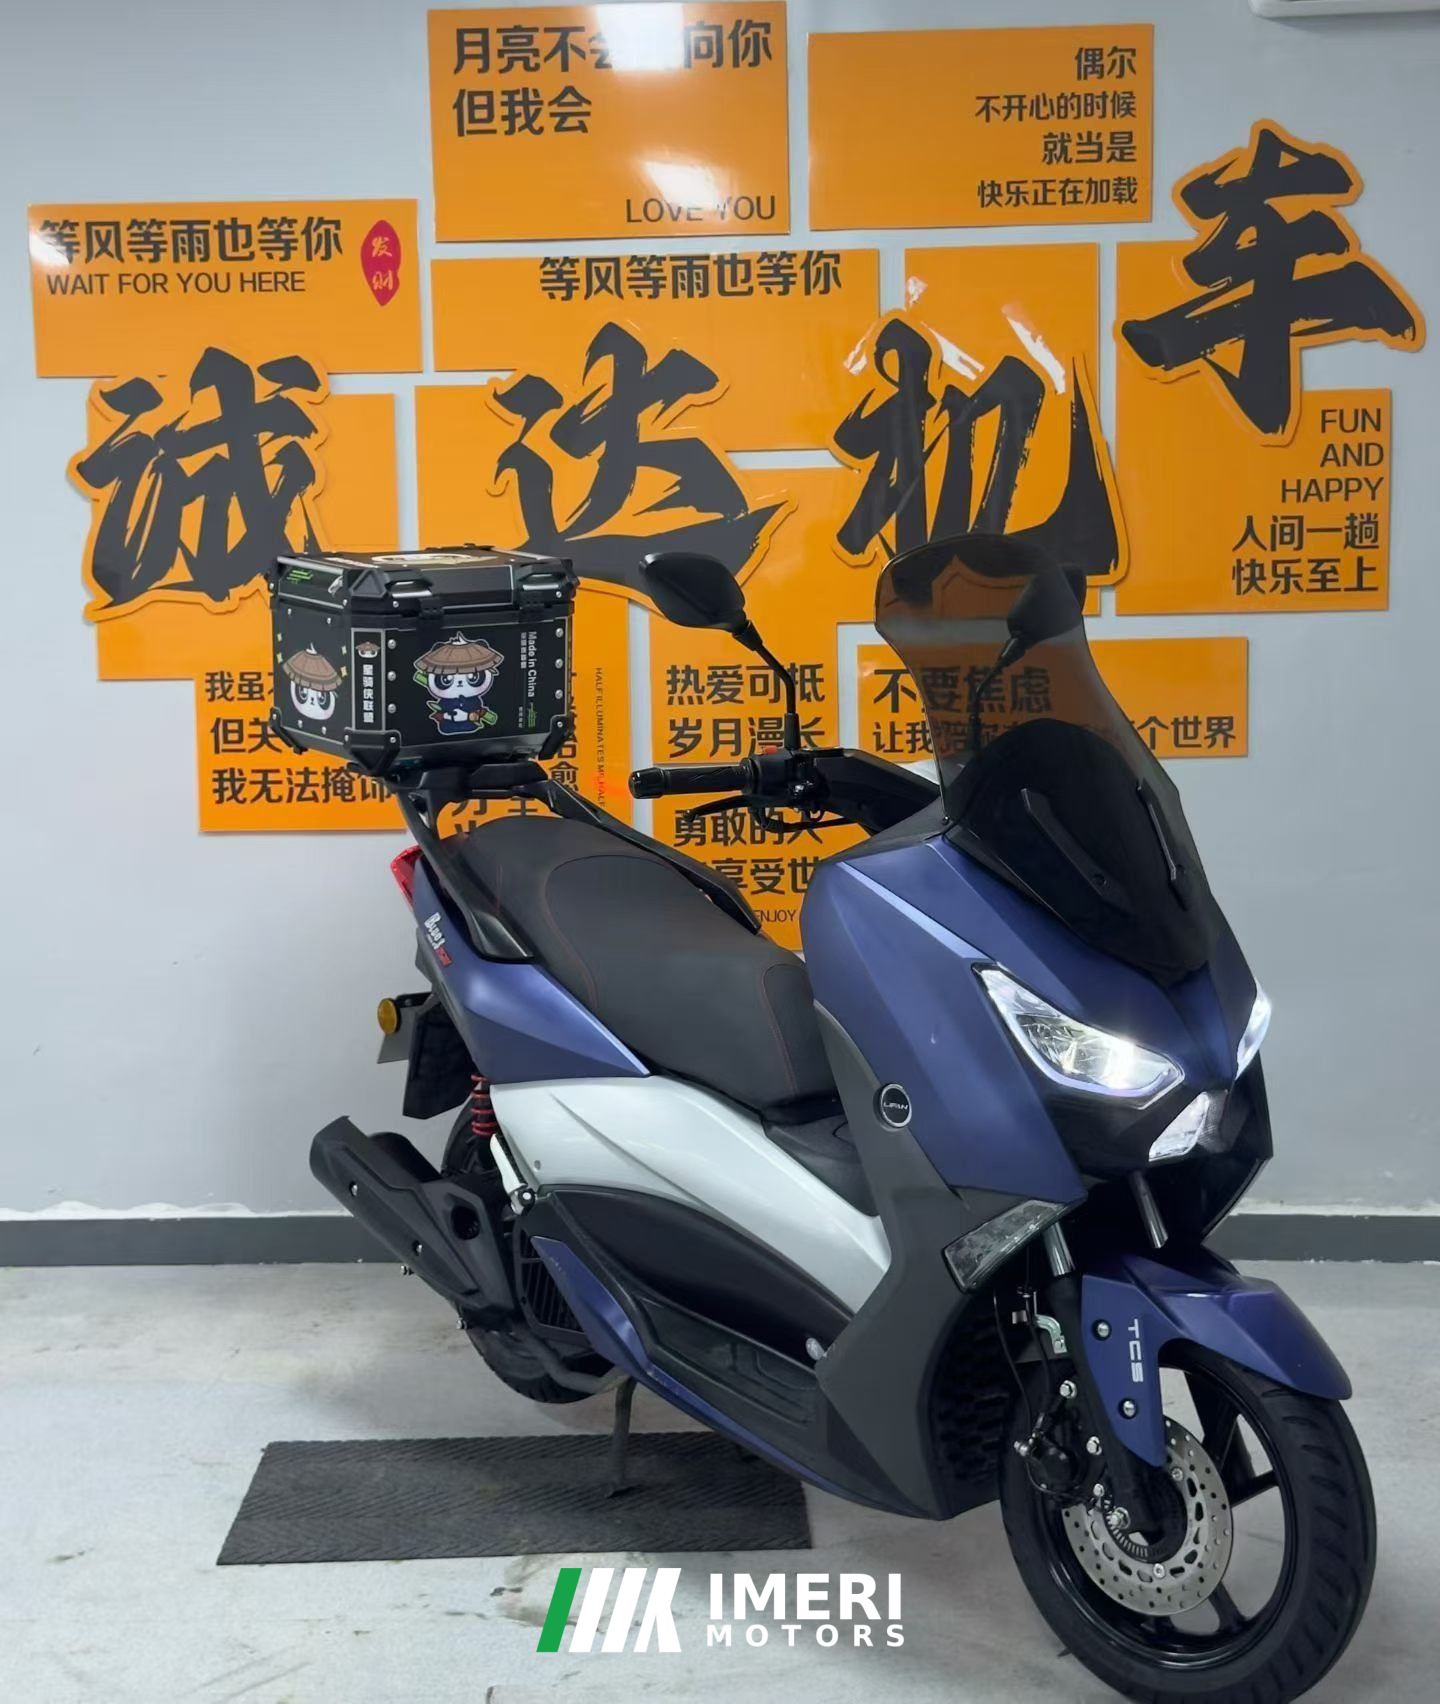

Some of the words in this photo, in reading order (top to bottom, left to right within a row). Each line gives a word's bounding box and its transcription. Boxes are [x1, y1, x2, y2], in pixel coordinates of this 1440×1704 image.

[453, 19, 773, 75] 月亮不向你
[1075, 46, 1137, 81] 偶尔
[452, 85, 592, 137] 但我会
[975, 91, 1137, 123] 不开心的时候
[1042, 131, 1137, 165] 就当是
[977, 176, 1138, 208] 快乐正在加载
[40, 216, 343, 264] 等风等雨也等你
[47, 274, 109, 295] WAIT
[118, 273, 168, 294] FOR
[177, 272, 231, 293] YOU
[240, 271, 306, 292] HERE
[539, 249, 842, 301] 等风等雨也等你
[1320, 408, 1381, 433] FUN
[1320, 443, 1384, 468] AND
[1281, 477, 1384, 503] HAPPY
[1232, 512, 1379, 552] 人间一趟
[1232, 556, 1379, 595] 快乐至上
[205, 670, 274, 702] 我虽
[527, 669, 537, 698] China
[666, 663, 825, 705] 热爱可抵
[668, 717, 825, 758] 岁月漫长
[703, 856, 820, 895] 享受世
[1127, 1318, 1144, 1383] TCS
